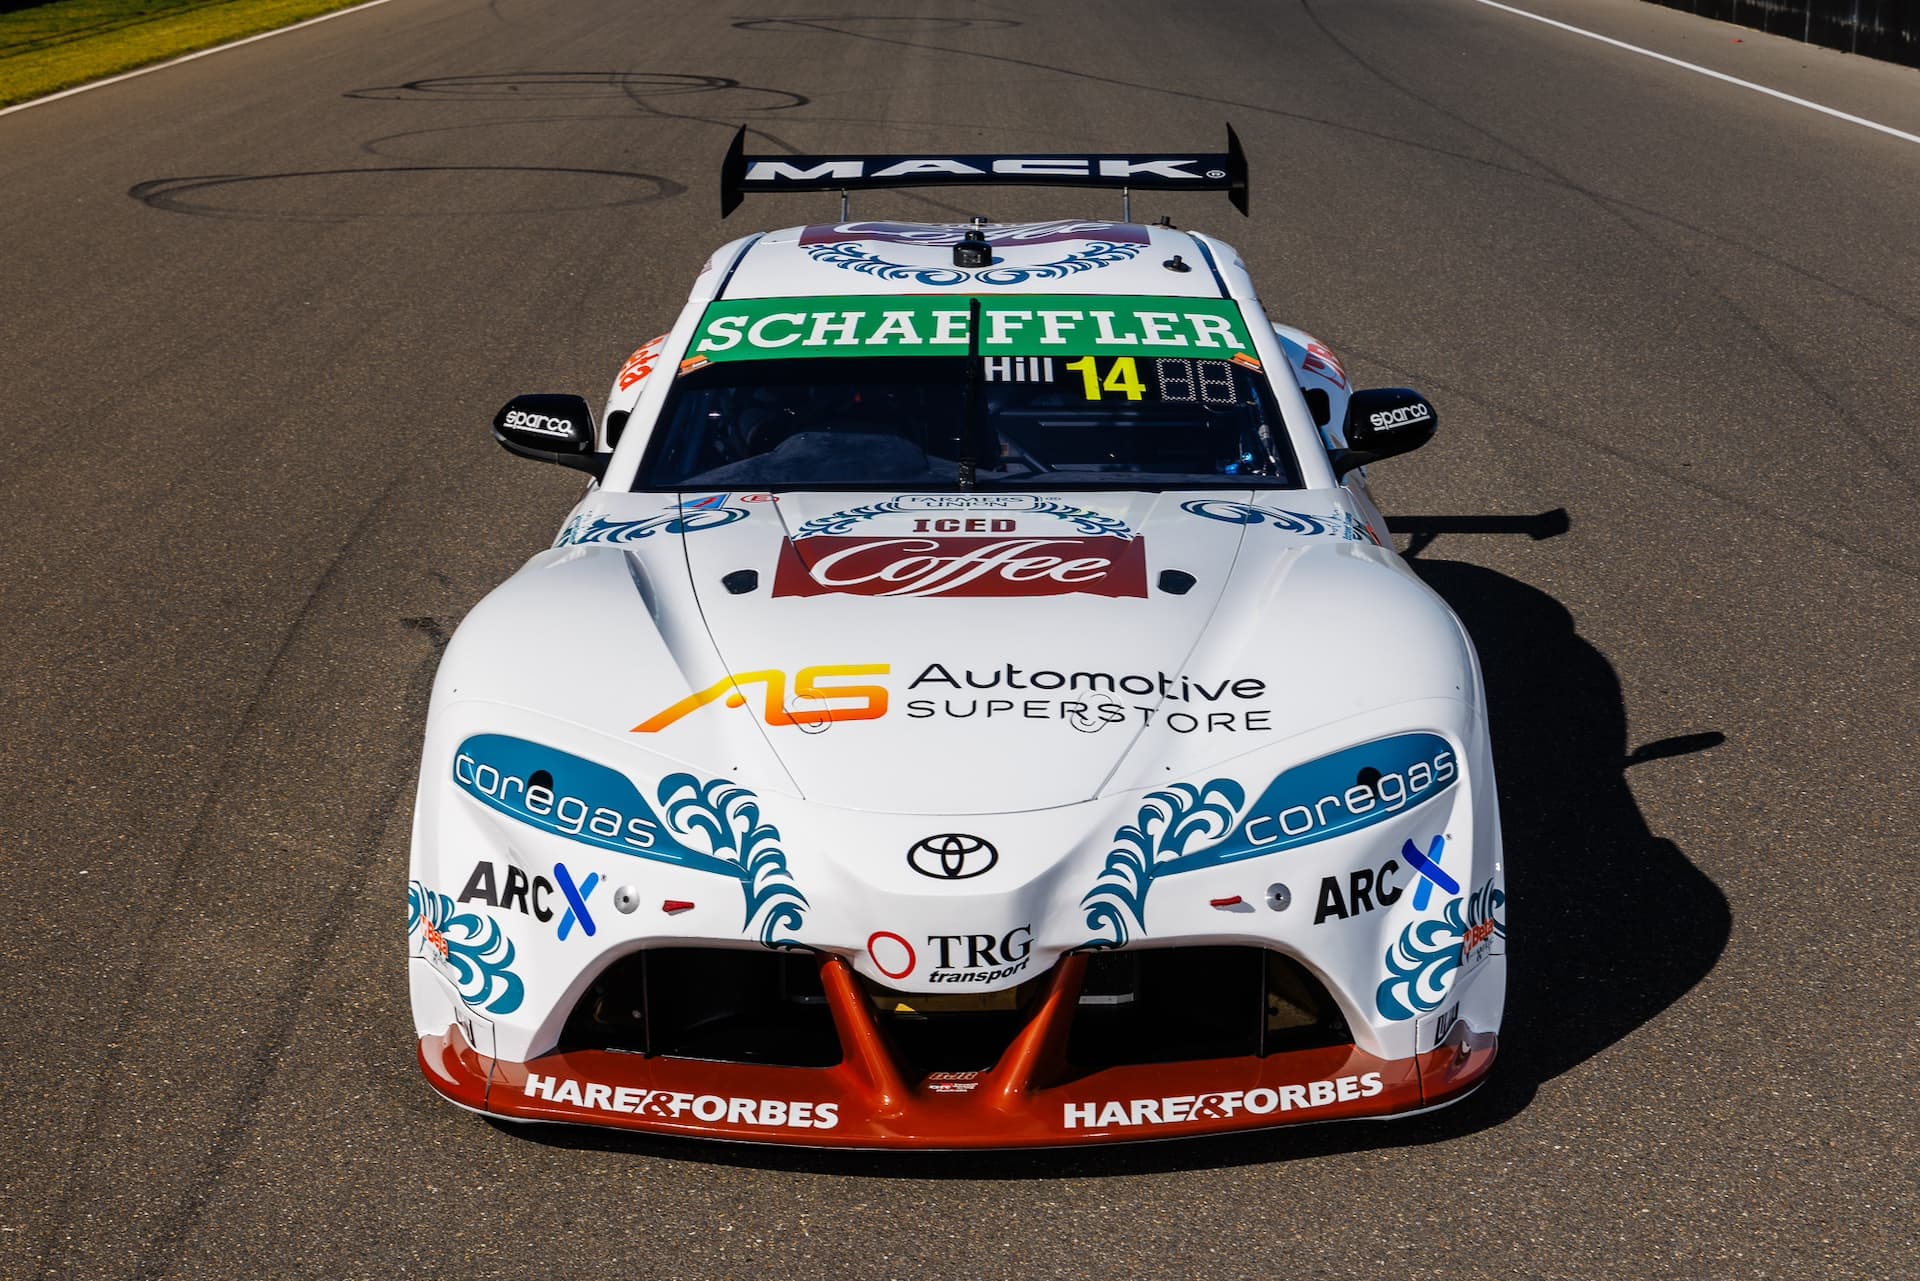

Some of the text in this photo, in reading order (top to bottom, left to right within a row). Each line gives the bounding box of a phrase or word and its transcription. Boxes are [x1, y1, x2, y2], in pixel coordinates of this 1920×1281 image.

[745, 160, 1203, 181] MACK
[696, 310, 1246, 352] SCHAEFFLER
[984, 356, 1147, 401] Hill 14
[505, 411, 573, 434] sparco
[1370, 403, 1428, 430] sparco
[912, 519, 1017, 533] ICED
[809, 539, 1111, 598] Coffee
[908, 663, 1266, 702] Automotive
[907, 700, 1272, 734] SUPERSTORE
[455, 752, 660, 849] coregas
[1243, 750, 1457, 847] coregas
[456, 860, 599, 942] ARCX
[1313, 834, 1461, 926] ARCX
[927, 924, 1035, 969] TRG
[929, 957, 1030, 984] transport
[524, 1073, 839, 1130] HARE&FORBES
[1063, 1072, 1384, 1129] HARE&FORBES
